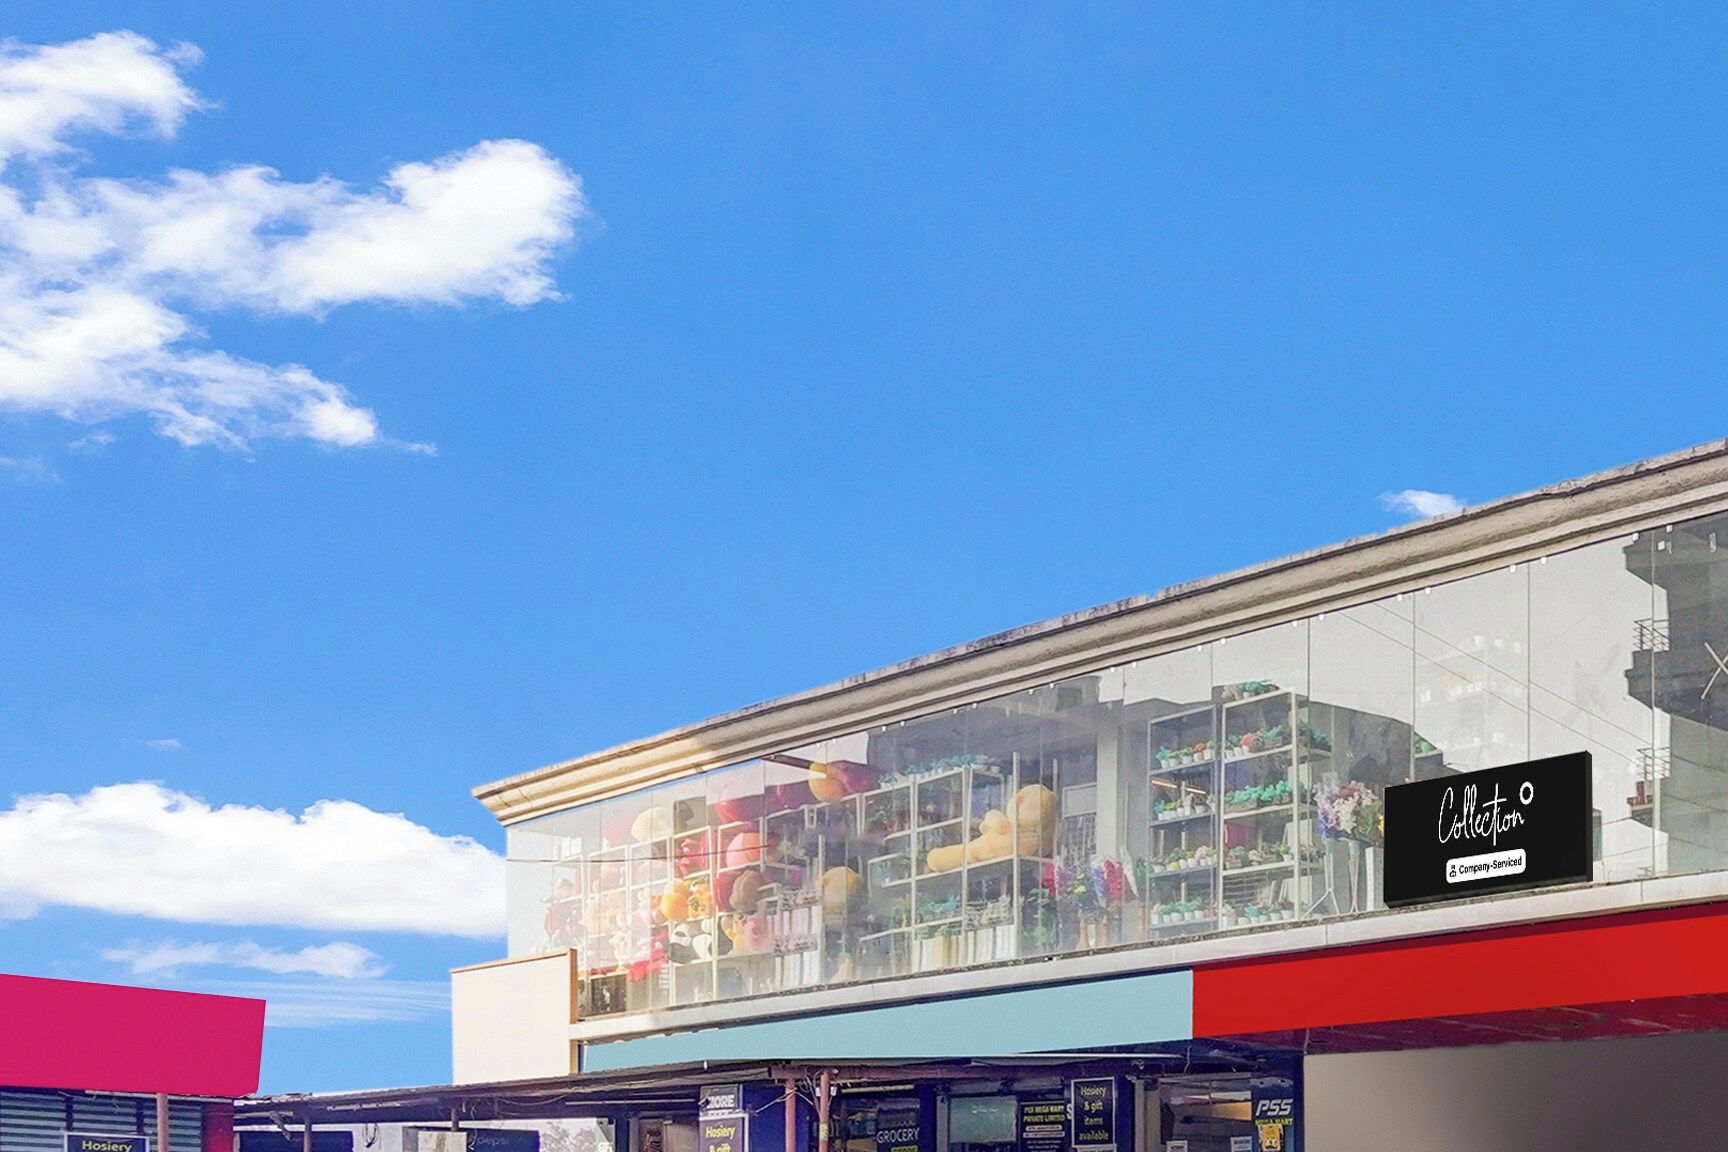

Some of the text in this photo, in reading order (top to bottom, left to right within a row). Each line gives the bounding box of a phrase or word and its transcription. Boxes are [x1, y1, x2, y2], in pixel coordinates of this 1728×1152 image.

[1439, 783, 1524, 846] Collection
[1459, 856, 1522, 875] Company-Serviced
[1080, 1085, 1106, 1097] Hosiery
[1091, 1100, 1103, 1113] gift
[1255, 1099, 1294, 1116] PSS
[1084, 1115, 1103, 1126] items
[705, 1126, 735, 1140] Hosiery
[877, 1127, 920, 1144] GROCERY
